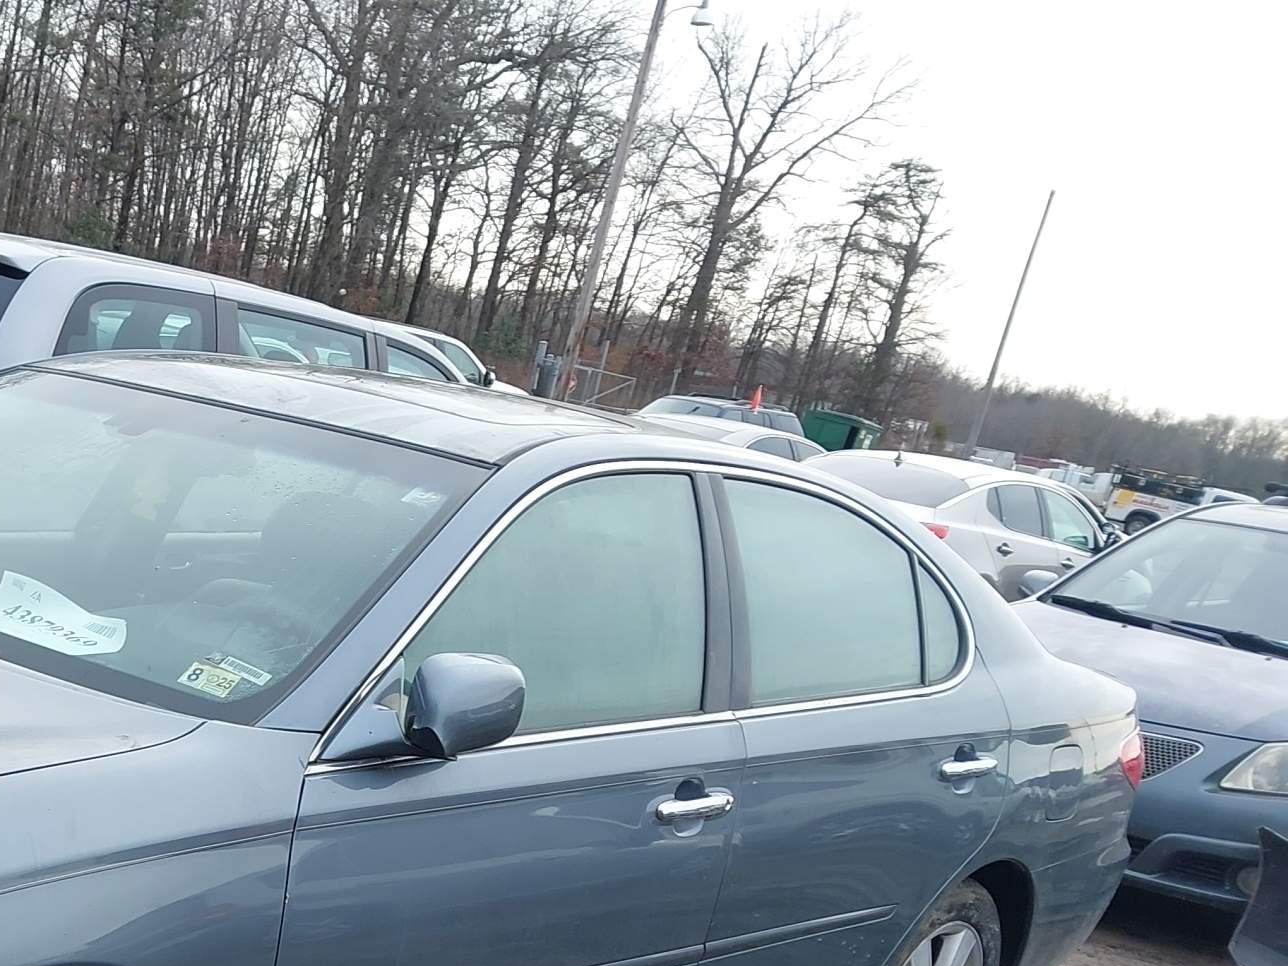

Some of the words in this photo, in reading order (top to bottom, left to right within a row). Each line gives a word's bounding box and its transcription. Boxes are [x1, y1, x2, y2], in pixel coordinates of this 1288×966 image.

[1, 604, 99, 647] 43879369
[186, 667, 204, 682] 8
[215, 676, 236, 690] 25
